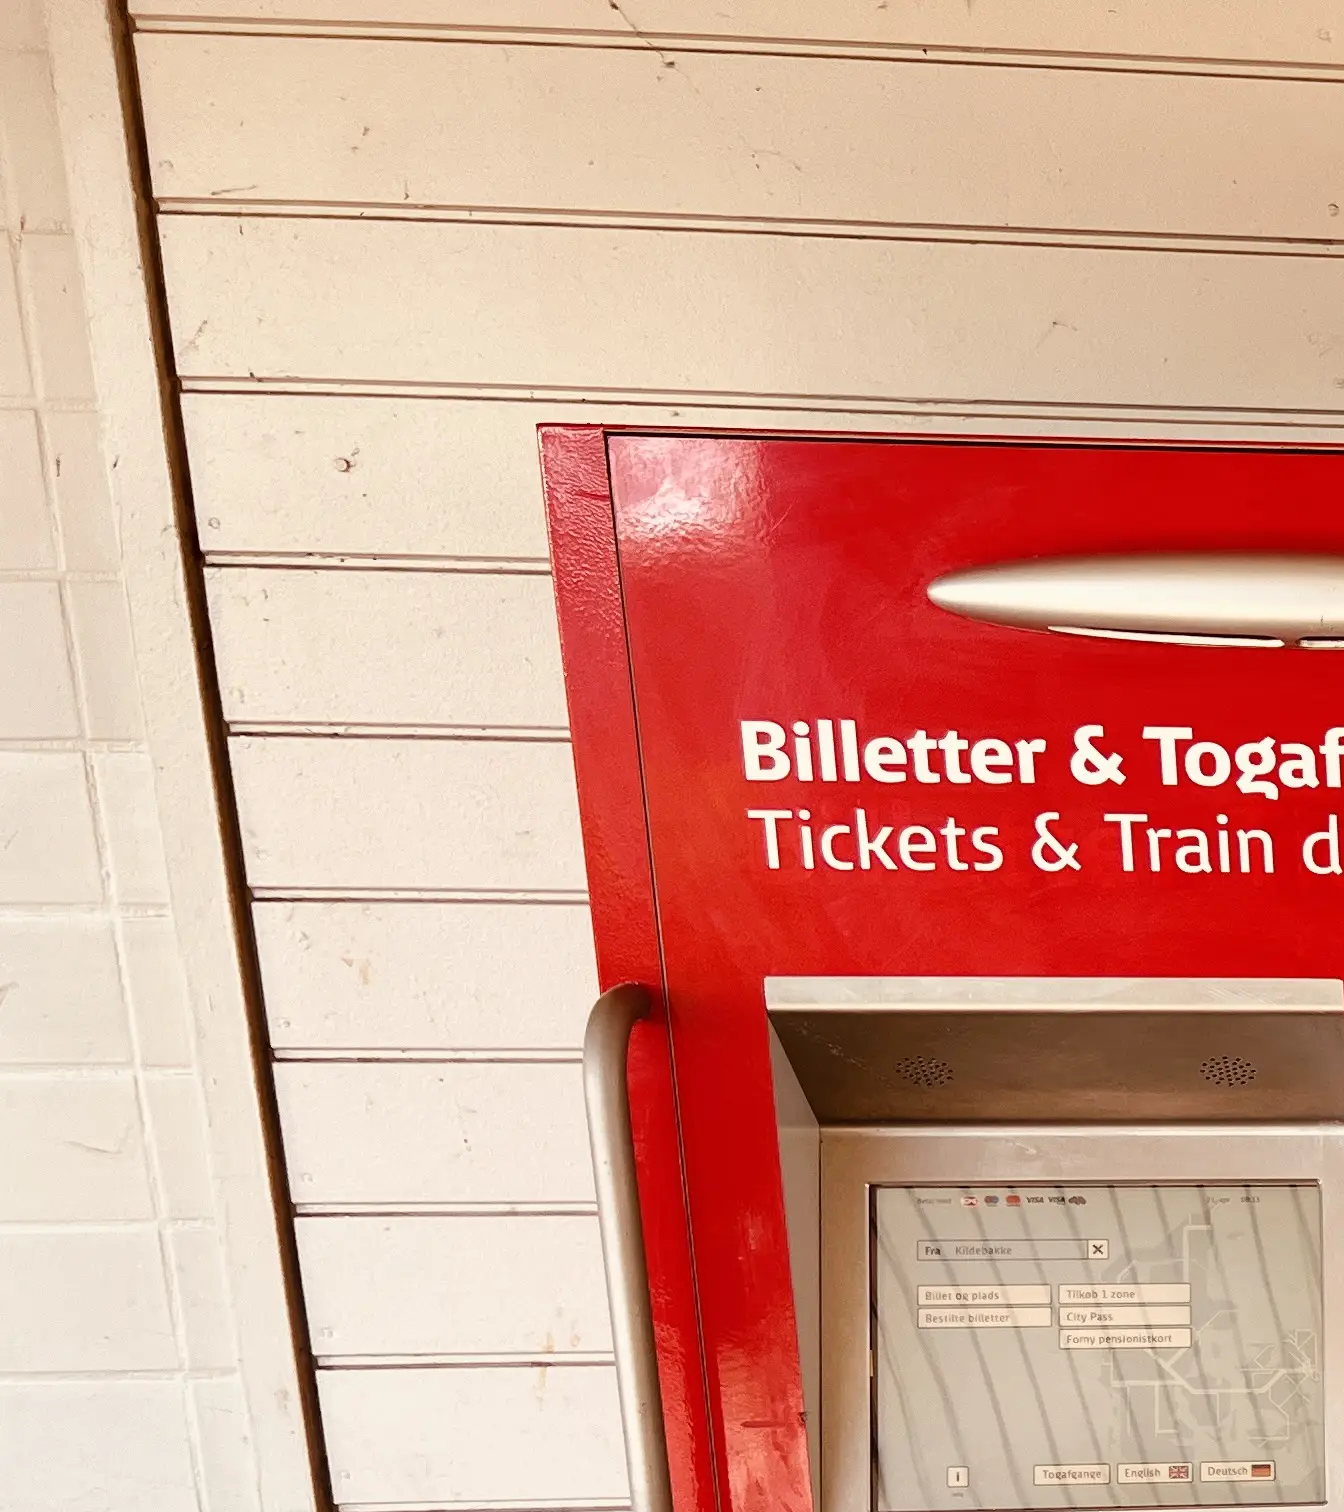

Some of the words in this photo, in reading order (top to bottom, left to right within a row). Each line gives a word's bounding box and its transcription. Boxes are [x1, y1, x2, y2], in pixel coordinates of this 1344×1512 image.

[739, 719, 1046, 785] Billetter
[1070, 724, 1127, 787] &
[747, 808, 1003, 873] Tickets
[1030, 811, 1082, 873] &
[1103, 812, 1275, 875] Train
[925, 1246, 941, 1255] Fra
[955, 1292, 969, 1302] og
[971, 1291, 1000, 1302] plads
[1066, 1290, 1098, 1299] Tilkøb
[1110, 1291, 1136, 1299] zone
[925, 1313, 965, 1323] Bestilte
[968, 1312, 1010, 1323] billetter
[1066, 1312, 1087, 1324] City
[1090, 1312, 1113, 1322] Pass
[1098, 1334, 1173, 1345] pensionistkort
[1042, 1469, 1102, 1481] Togafgange
[1124, 1468, 1161, 1479] English
[1207, 1466, 1248, 1476] Deutsch
